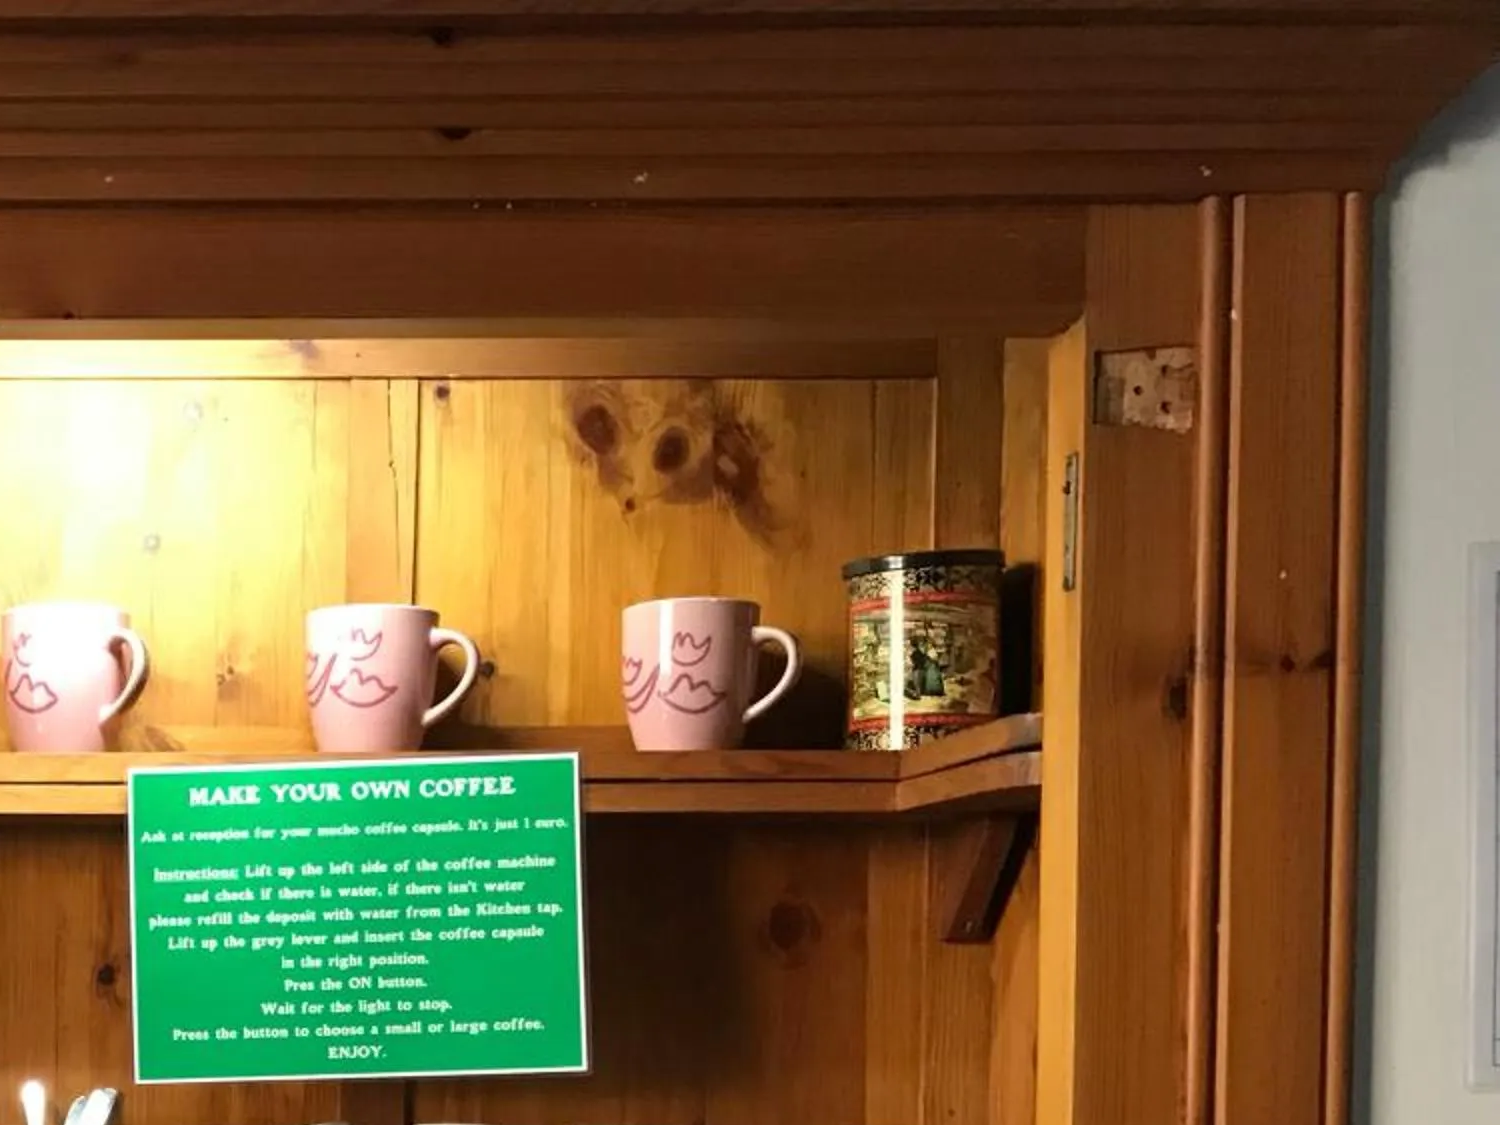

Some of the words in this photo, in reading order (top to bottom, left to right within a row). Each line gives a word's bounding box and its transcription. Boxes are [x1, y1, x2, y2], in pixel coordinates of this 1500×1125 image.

[188, 784, 260, 806] MAKE
[270, 782, 341, 802] YOUR
[351, 780, 409, 800] OWN
[419, 775, 516, 797] COFFEE
[171, 831, 184, 841] at
[253, 827, 275, 838] for
[280, 827, 311, 840] your
[316, 823, 361, 836] mucho
[363, 821, 407, 834] coffee
[493, 818, 518, 832] just
[523, 817, 529, 828] 1
[244, 863, 271, 877] Lift
[277, 866, 295, 878] up
[301, 863, 323, 875] the
[329, 861, 353, 874] left
[360, 860, 387, 873] side
[393, 859, 409, 872] of
[415, 858, 438, 871] the
[443, 856, 491, 870] coffee
[497, 855, 556, 868] machine
[183, 889, 208, 902] and
[214, 888, 254, 901] check
[260, 887, 272, 900] if
[278, 887, 314, 899] there
[320, 885, 331, 897] is
[405, 882, 441, 894] there
[447, 880, 476, 893] isn't
[483, 881, 525, 891] water
[148, 914, 191, 930] please
[196, 911, 232, 925] refill
[238, 911, 260, 924] the
[265, 910, 316, 925] deposit
[323, 907, 354, 920] with
[359, 908, 399, 919] water
[405, 905, 441, 918] from
[447, 903, 469, 916] the
[476, 902, 530, 915] Kitchen
[167, 936, 194, 949] Lift
[201, 938, 217, 951] up
[223, 935, 245, 947] the
[251, 936, 284, 949] grey
[291, 933, 327, 944] lever
[333, 931, 358, 944] and
[364, 930, 404, 942] insert
[410, 928, 432, 940] the
[438, 927, 485, 940] coffee
[491, 924, 544, 940] capsule
[300, 955, 322, 968] the
[328, 954, 362, 969] right
[320, 977, 342, 990] the
[348, 976, 371, 988] ON
[260, 1001, 294, 1014] Wait
[301, 1001, 324, 1014] for
[330, 1001, 352, 1012] the
[358, 999, 390, 1014] light
[397, 1000, 412, 1011] to
[172, 1028, 209, 1040] Press
[215, 1027, 236, 1039] the
[243, 1026, 288, 1038] button
[294, 1026, 309, 1036] to
[315, 1023, 364, 1036] choose
[370, 1025, 378, 1034] a
[385, 1021, 421, 1034] small
[427, 1023, 443, 1032] or
[450, 1020, 487, 1034] large
[327, 1045, 385, 1058] ENJOY.
